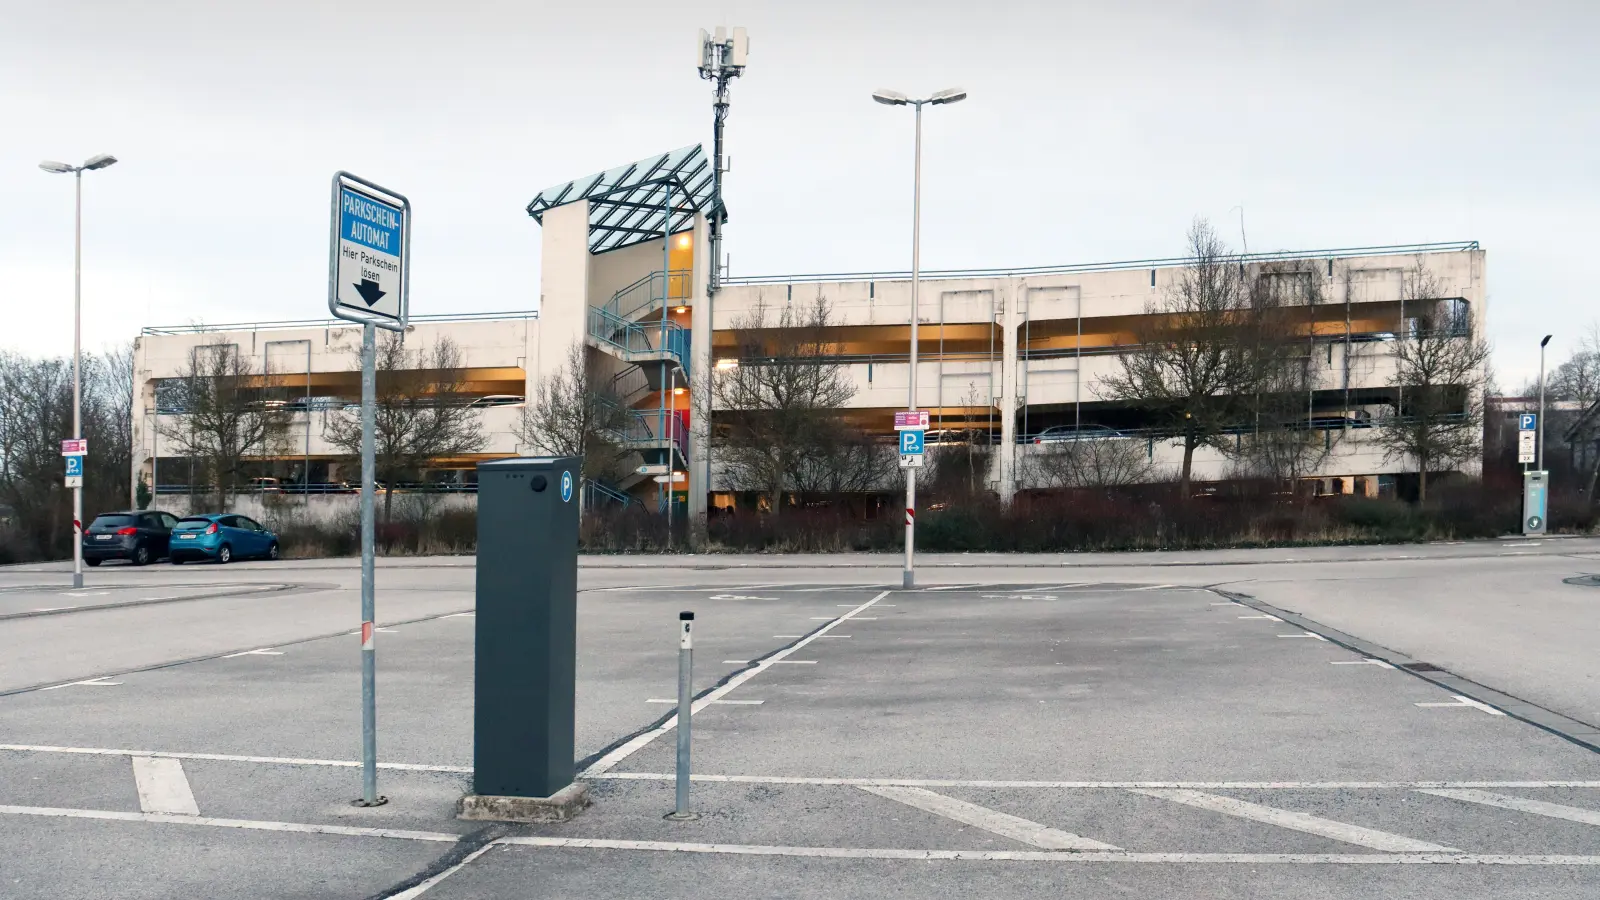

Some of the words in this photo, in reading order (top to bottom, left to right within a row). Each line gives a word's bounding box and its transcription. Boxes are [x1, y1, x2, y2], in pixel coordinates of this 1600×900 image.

[343, 193, 399, 230] PARKSCHEIN-
[350, 220, 390, 250] AUTOMAT
[342, 245, 358, 261] Hier
[360, 251, 398, 273] Parkschein
[361, 266, 380, 282] lösen
[1522, 416, 1532, 429] P
[903, 433, 917, 452] P
[67, 458, 77, 474] P
[563, 476, 570, 496] P
